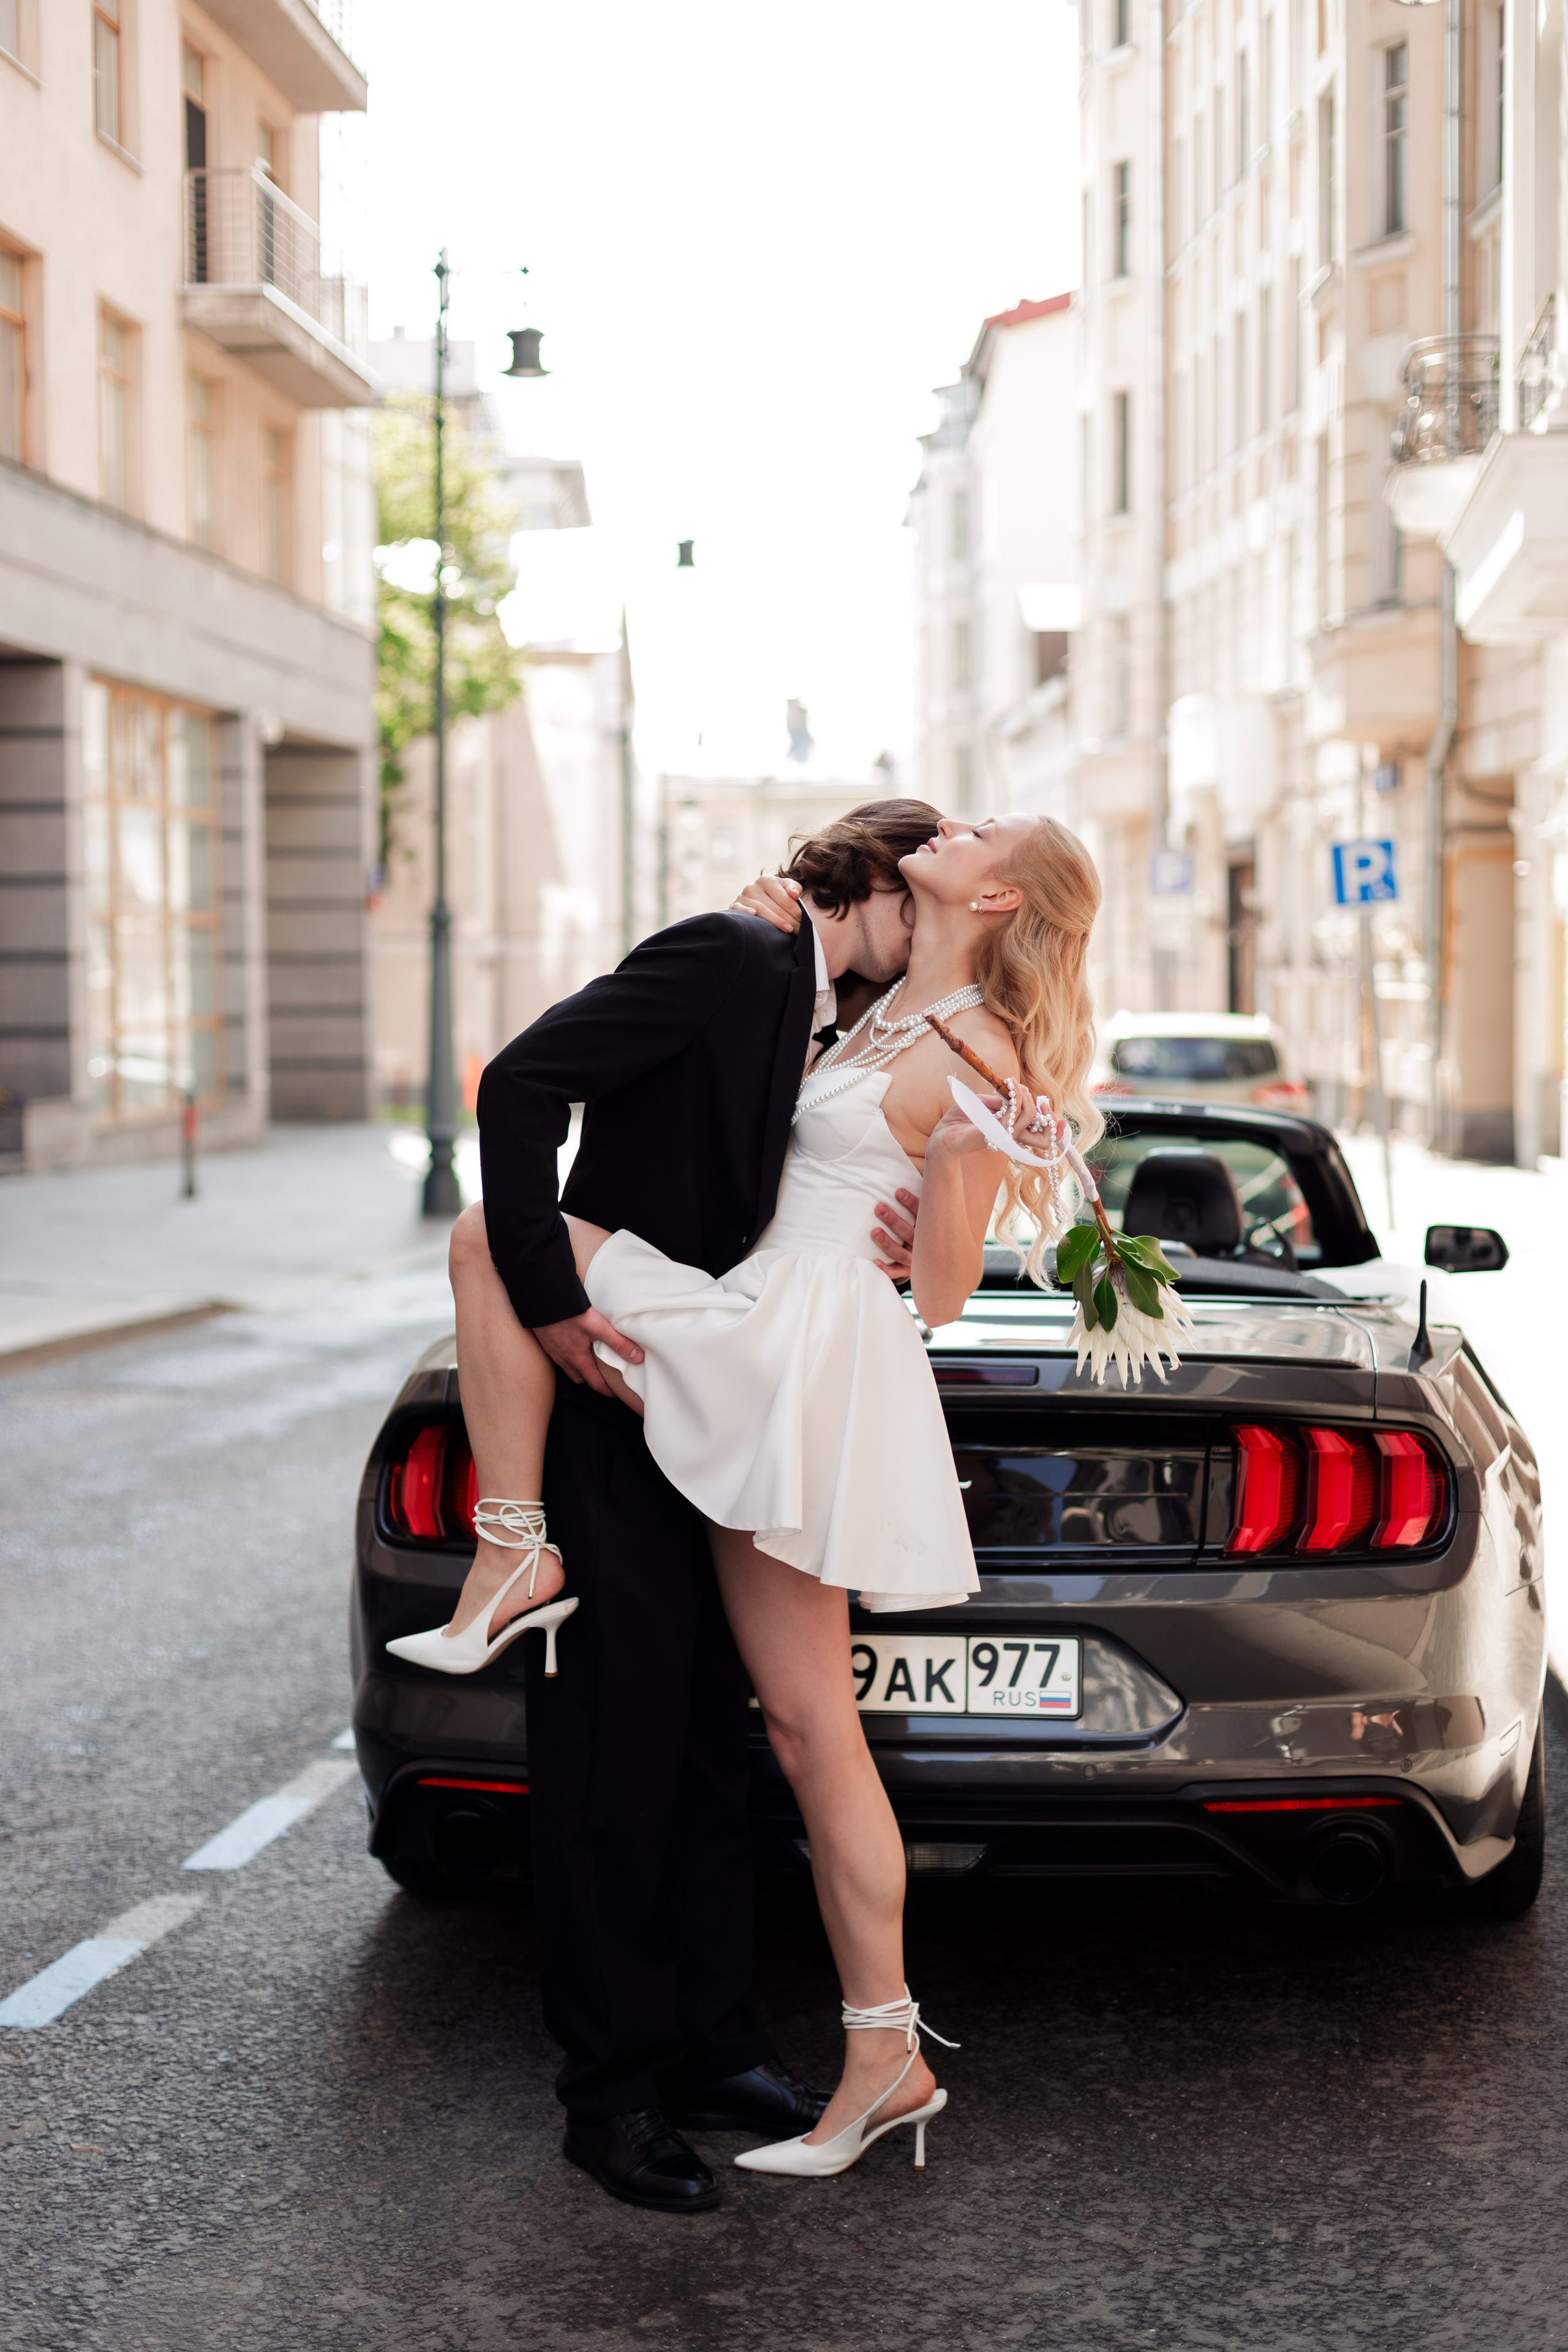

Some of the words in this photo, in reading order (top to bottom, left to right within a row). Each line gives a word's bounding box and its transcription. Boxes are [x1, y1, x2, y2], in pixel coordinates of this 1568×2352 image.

[1343, 843, 1387, 900] P
[972, 1643, 1060, 1688] 977
[993, 1691, 1036, 1706] RUS
